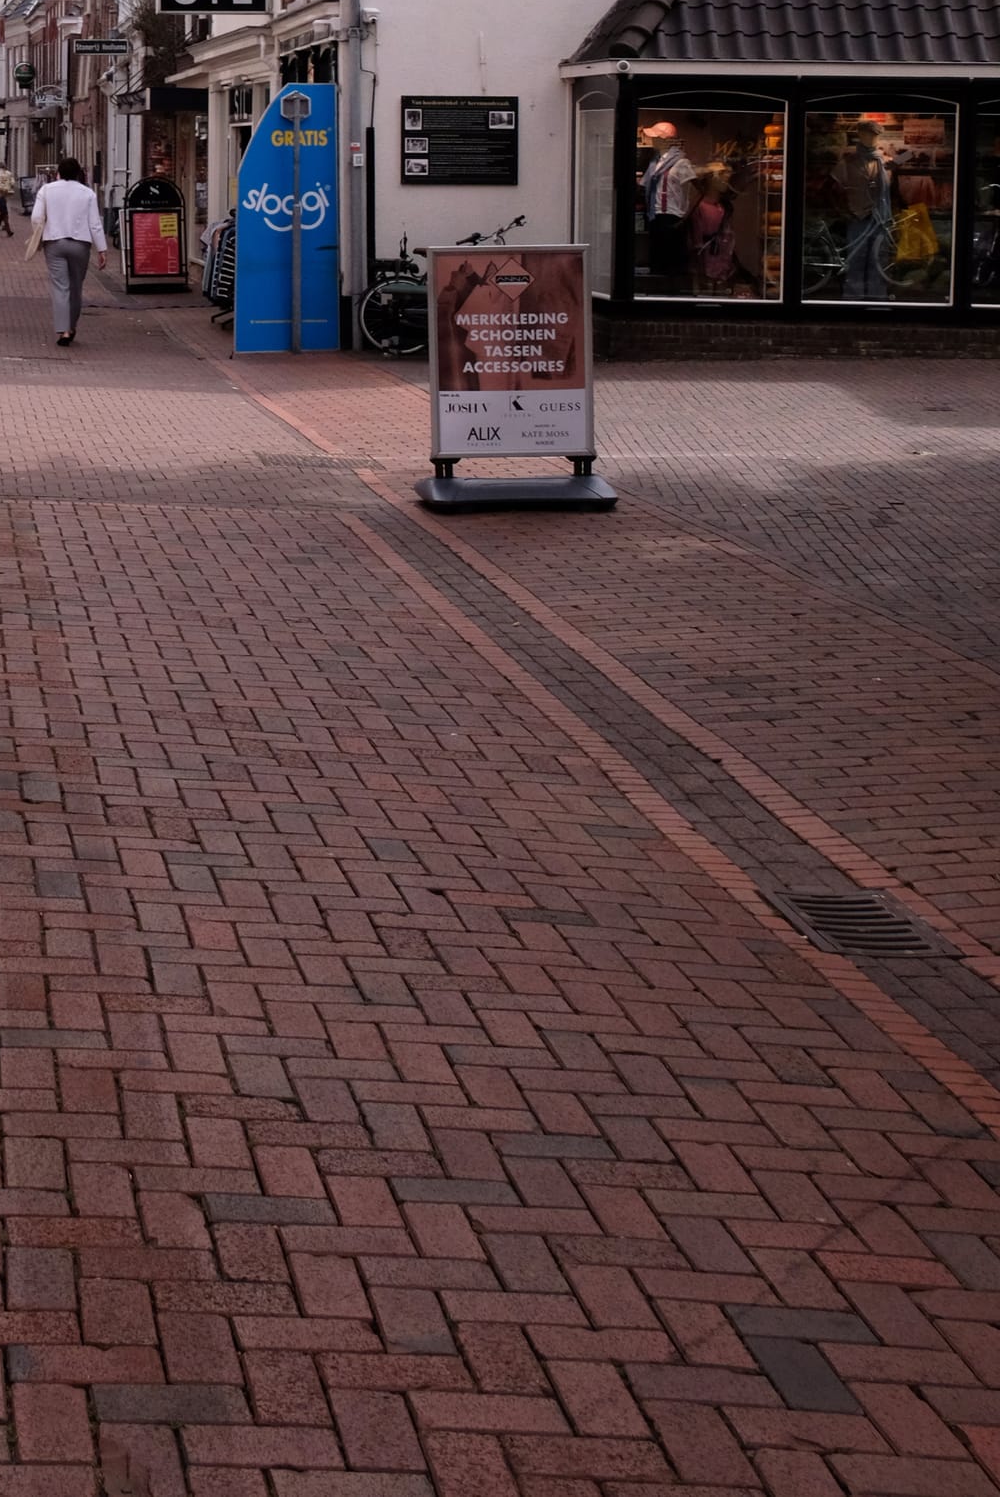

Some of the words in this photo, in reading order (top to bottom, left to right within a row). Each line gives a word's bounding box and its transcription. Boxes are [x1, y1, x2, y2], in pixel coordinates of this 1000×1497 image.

[456, 313, 569, 326] MERKKLEDING
[470, 329, 556, 341] SCHOENEN
[484, 345, 543, 357] TASSEN
[463, 361, 565, 374] ACCESSOIRES
[445, 403, 478, 413] JOSH
[539, 402, 582, 413] GUESS
[467, 427, 501, 441] ALIX
